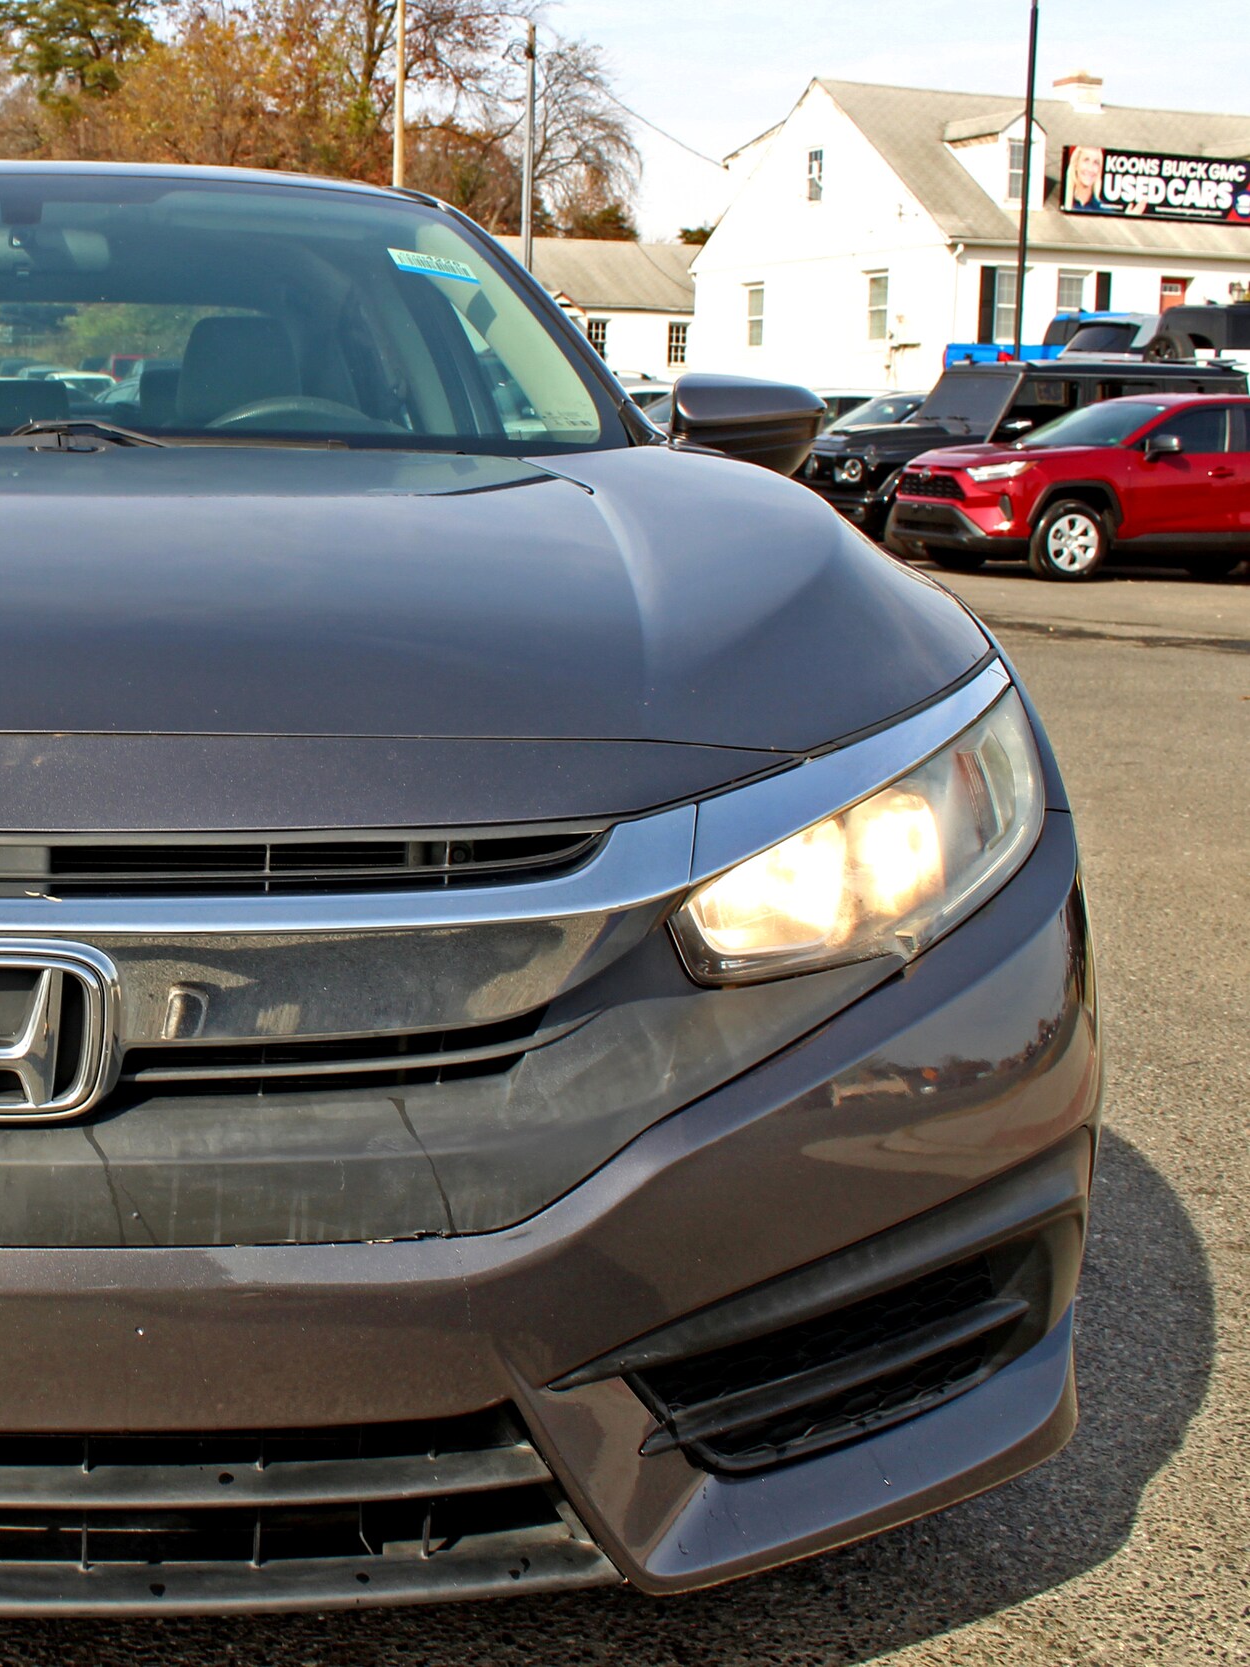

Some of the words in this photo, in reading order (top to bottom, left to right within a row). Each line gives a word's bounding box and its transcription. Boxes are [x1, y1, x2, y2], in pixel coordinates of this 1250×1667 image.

[1105, 155, 1160, 175] KOONS
[1162, 159, 1209, 179] BUICK
[1209, 163, 1246, 182] GMC
[1103, 173, 1166, 204] USED
[1167, 178, 1233, 209] CARS
